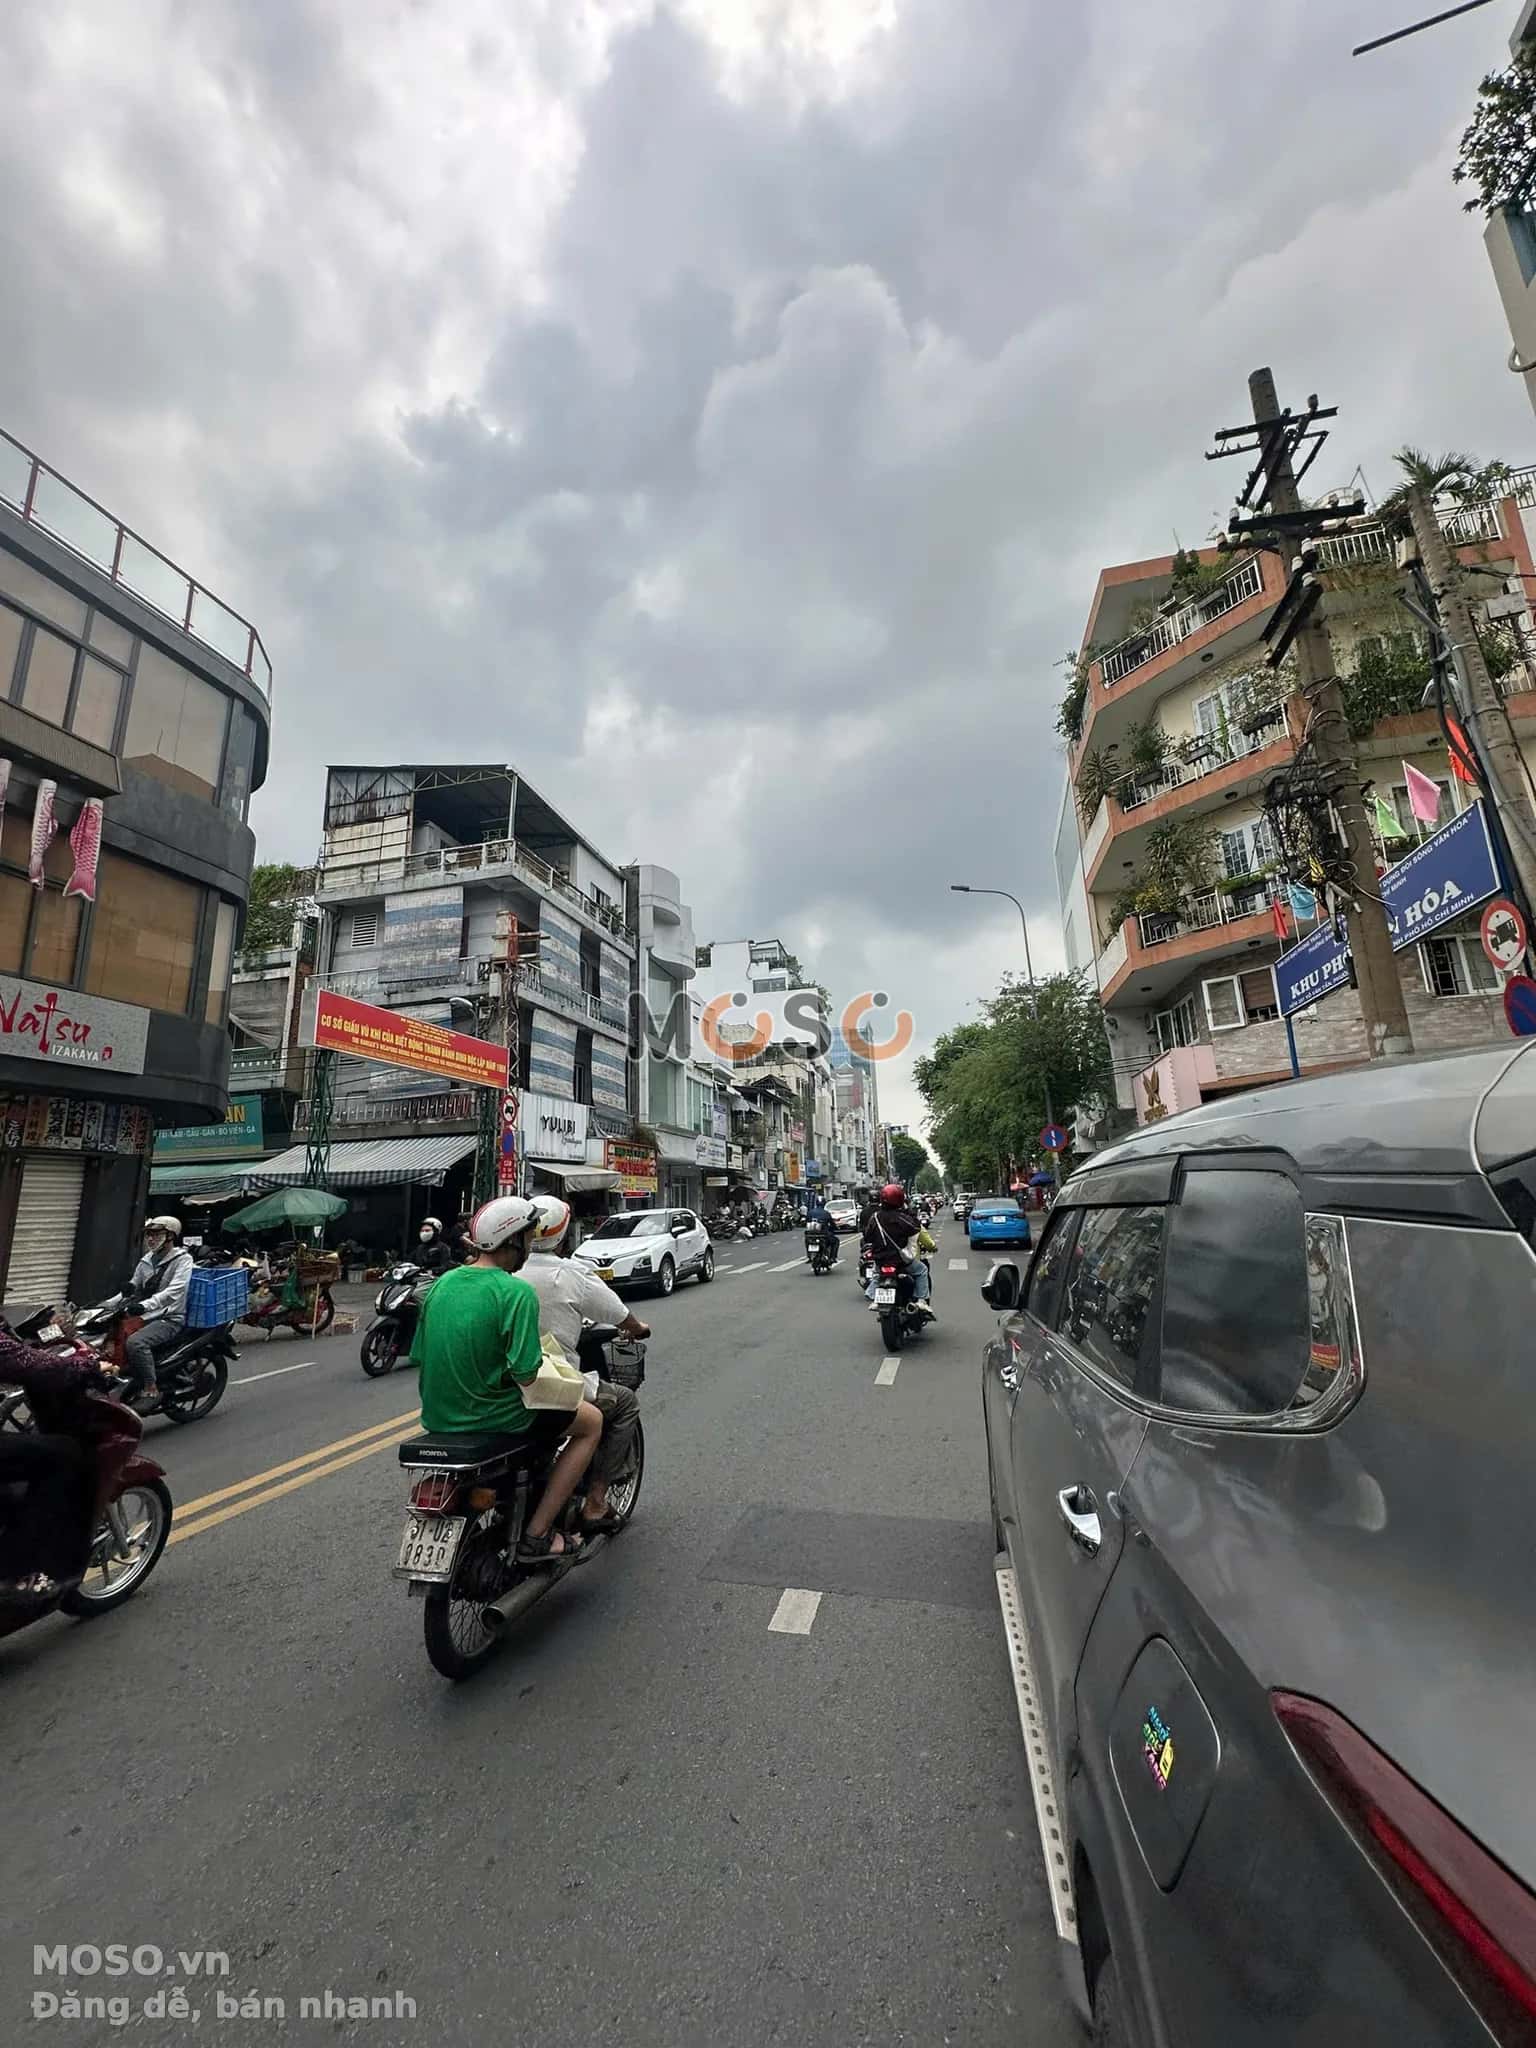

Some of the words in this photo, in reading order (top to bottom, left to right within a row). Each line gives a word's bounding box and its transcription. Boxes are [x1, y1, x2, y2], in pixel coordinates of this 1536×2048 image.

[1450, 892, 1475, 912] MINH
[1290, 969, 1319, 1000] KHU
[1404, 880, 1463, 928] HÓA
[321, 1013, 331, 1027] CƠ
[332, 1013, 343, 1030] SỞ
[52, 1044, 99, 1062] IZAKAYA
[419, 1449, 448, 1457] HONDA
